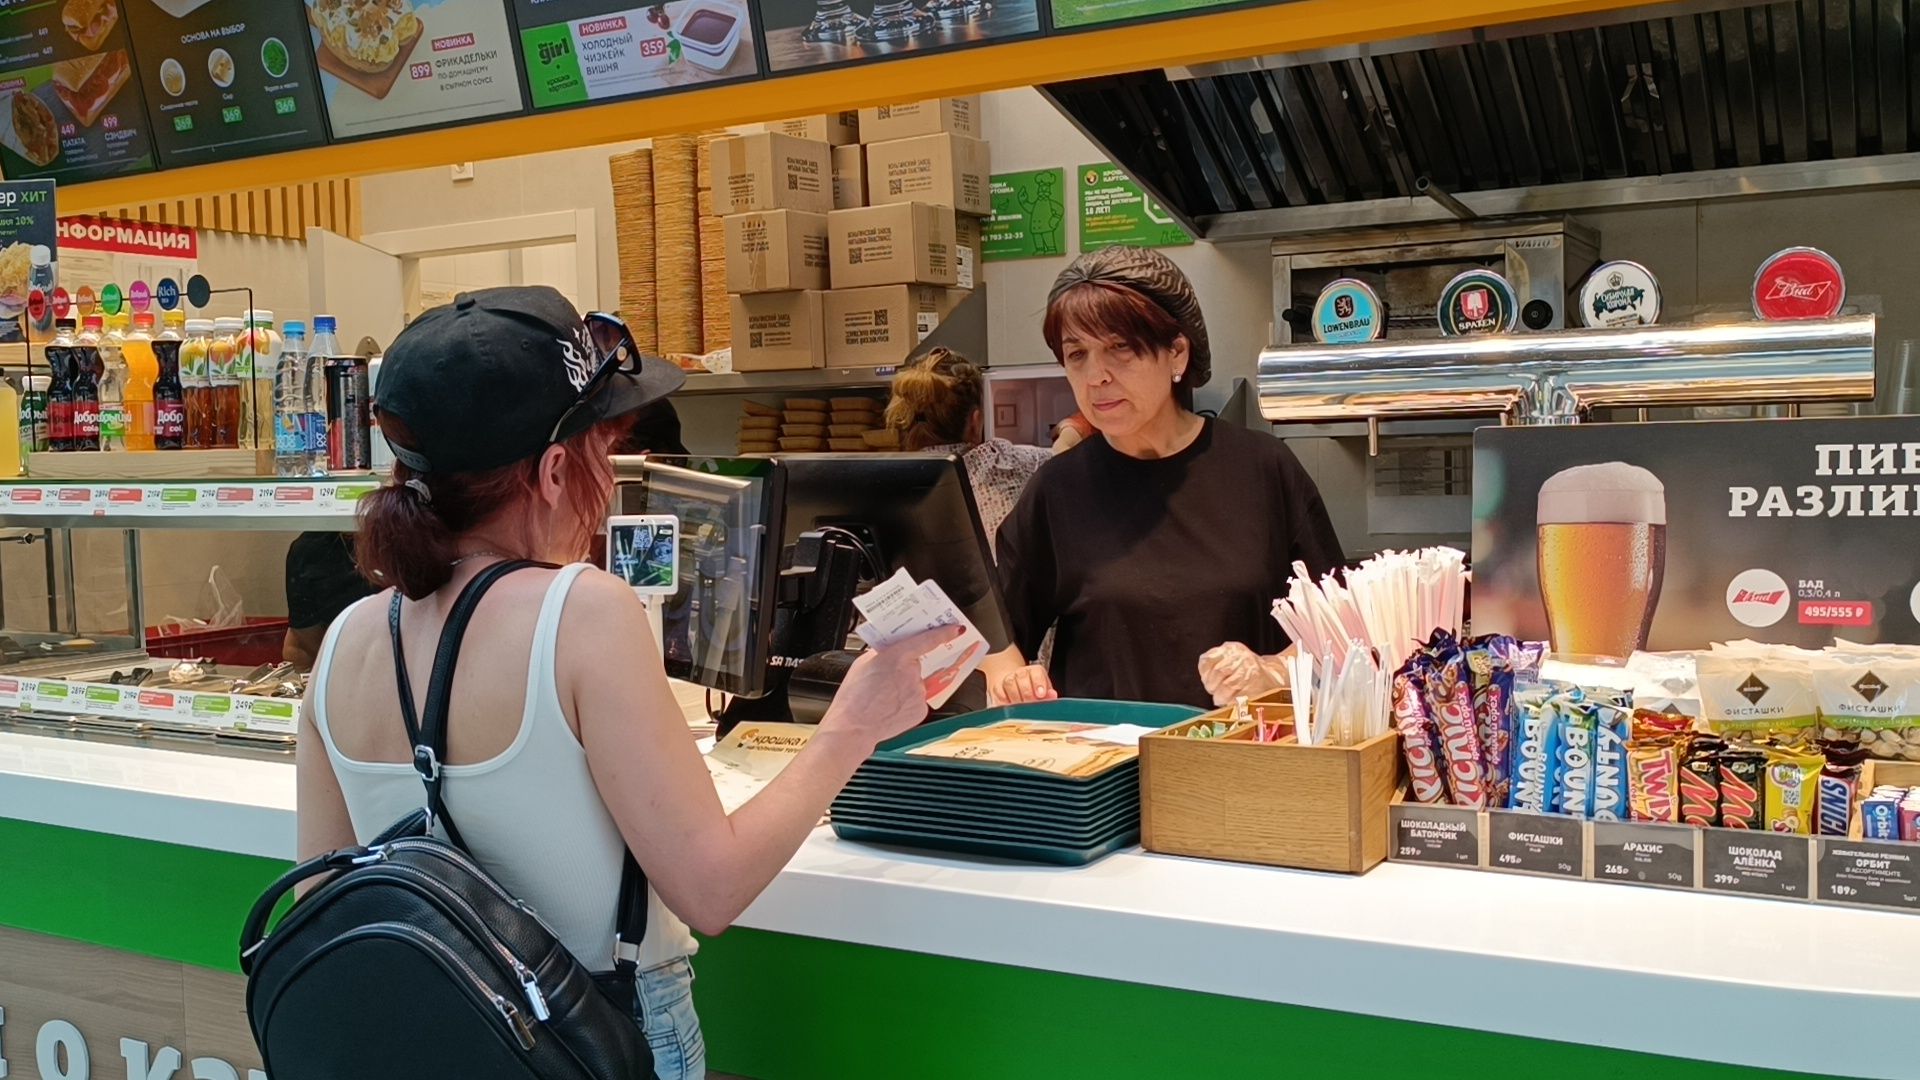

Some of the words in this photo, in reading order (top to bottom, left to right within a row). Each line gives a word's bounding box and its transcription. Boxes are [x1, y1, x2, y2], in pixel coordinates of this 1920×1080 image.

[180, 31, 209, 44] ОСНОВА
[221, 23, 246, 36] ВЫБОР
[582, 19, 624, 34] НОВИНКА
[434, 34, 474, 49] НОВИНКА
[582, 33, 634, 51] ХОЛОДНЫЙ
[642, 39, 665, 56] 359
[538, 36, 570, 65] girl
[583, 49, 626, 63] ЧИЗКЕЙК
[435, 49, 498, 68] ФРИКАДЕЛЬКИ
[411, 63, 431, 78] 899
[586, 62, 619, 76] ВИШНЯ
[103, 116, 119, 129] 499
[20, 190, 48, 203] ХИТ
[15, 215, 34, 226] 10%
[56, 221, 191, 251] НФОРМАЦИЯ
[158, 285, 177, 298] Rich
[1776, 278, 1814, 298] Bud
[1458, 317, 1496, 330] SPATEN
[157, 409, 184, 424] Добр
[169, 425, 184, 433] col
[1728, 485, 1920, 518] РАЗЛИ
[1798, 580, 1824, 590] БАД
[1804, 606, 1853, 618] 495/555
[1724, 705, 1785, 717] ФИСТАШКИ
[1837, 701, 1903, 714] ФИСТАШКИ
[752, 735, 801, 746] крошка
[1563, 726, 1590, 816] BOUN
[1640, 750, 1673, 823] TWIX
[1400, 819, 1467, 833] ШОКОЛАДНЫЙ
[1410, 829, 1458, 841] БАТОНЧИК
[1508, 831, 1564, 846] ФИСТАШКИ
[1623, 841, 1664, 854] АРАХИС
[1728, 845, 1783, 861] ШОКОЛАД
[1732, 856, 1777, 869] АЛЁНКА
[1855, 858, 1891, 870] ОРБИТ
[1851, 867, 1902, 878] АССОРТИМЕНТЕ
